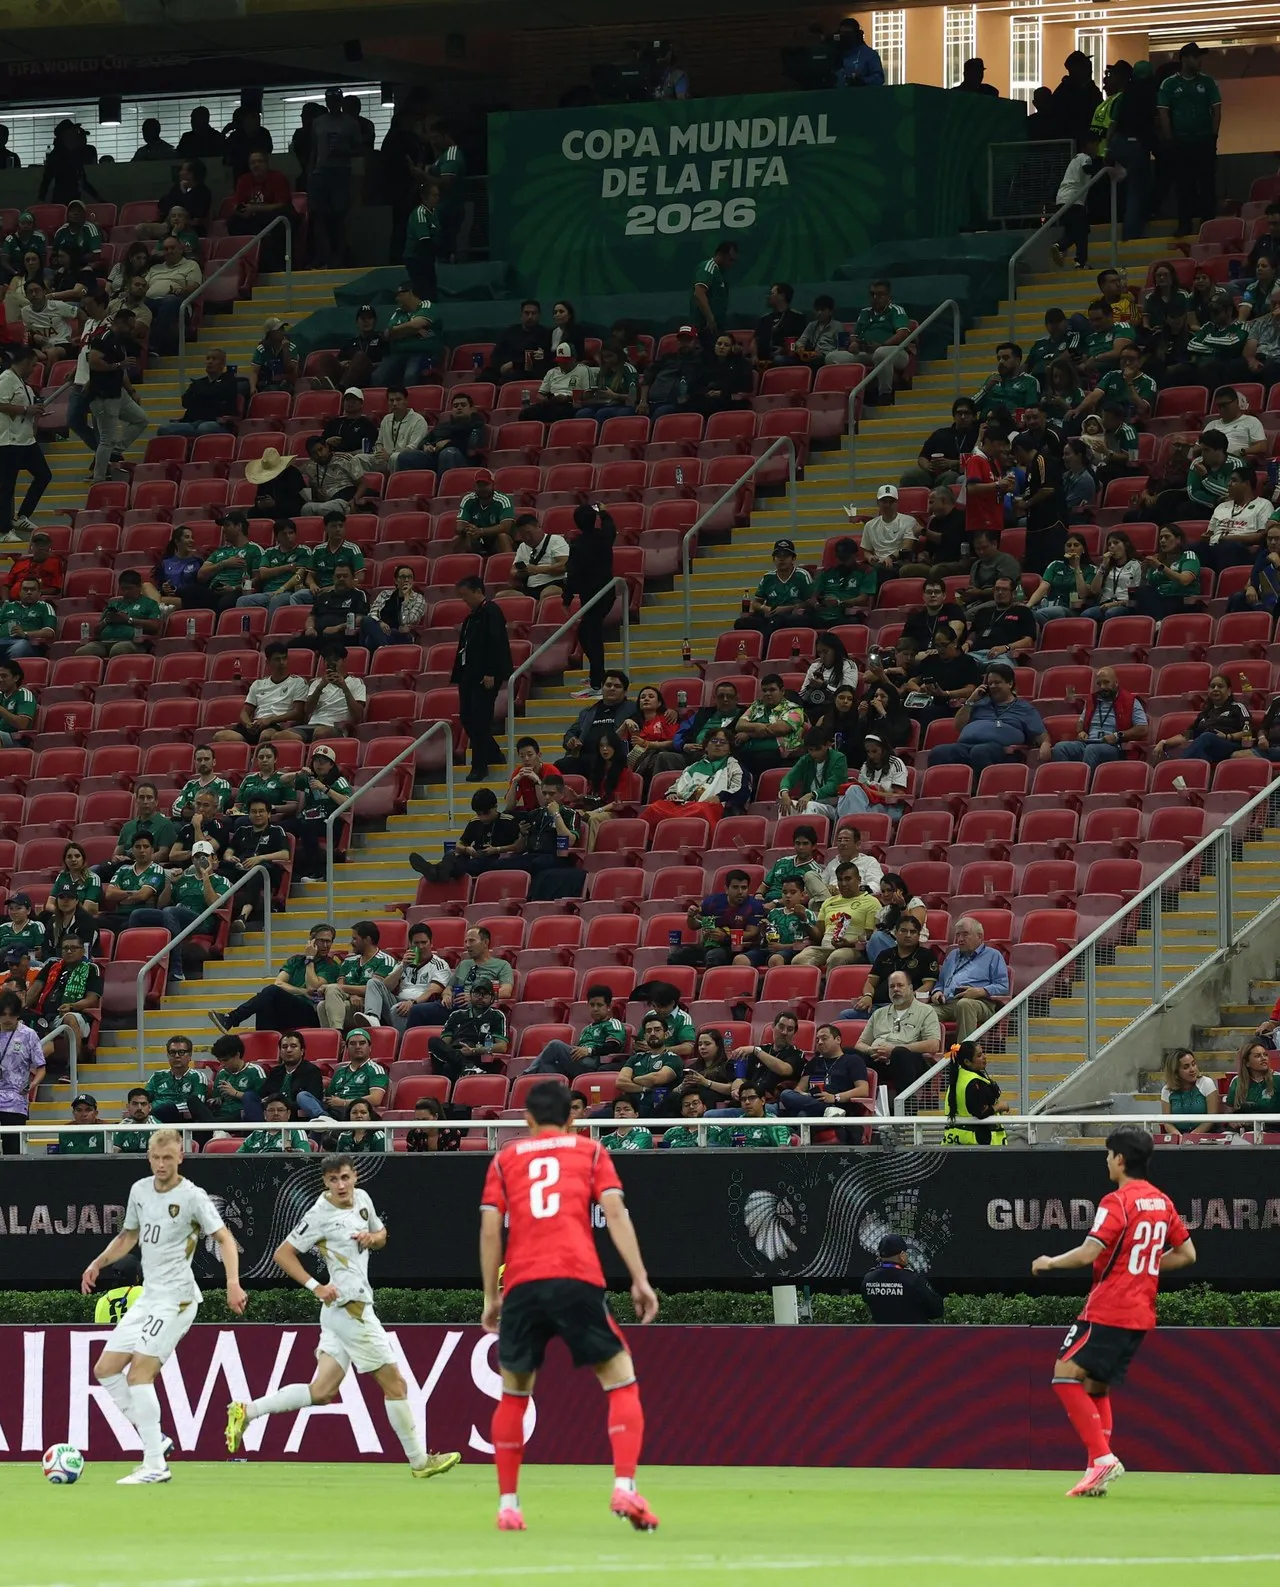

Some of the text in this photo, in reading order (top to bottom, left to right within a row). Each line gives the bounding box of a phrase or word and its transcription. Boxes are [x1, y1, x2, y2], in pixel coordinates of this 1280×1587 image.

[562, 114, 838, 161] COPA MUNDIAL
[601, 155, 790, 198] DE LA FIFA
[625, 197, 757, 236] 2026
[528, 1156, 560, 1219] 2
[142, 1223, 161, 1244] 20
[986, 1198, 1280, 1231] GUADJARA
[1128, 1220, 1168, 1276] 22
[866, 1288, 904, 1296] ZAPOPAN
[142, 1314, 164, 1337] 20
